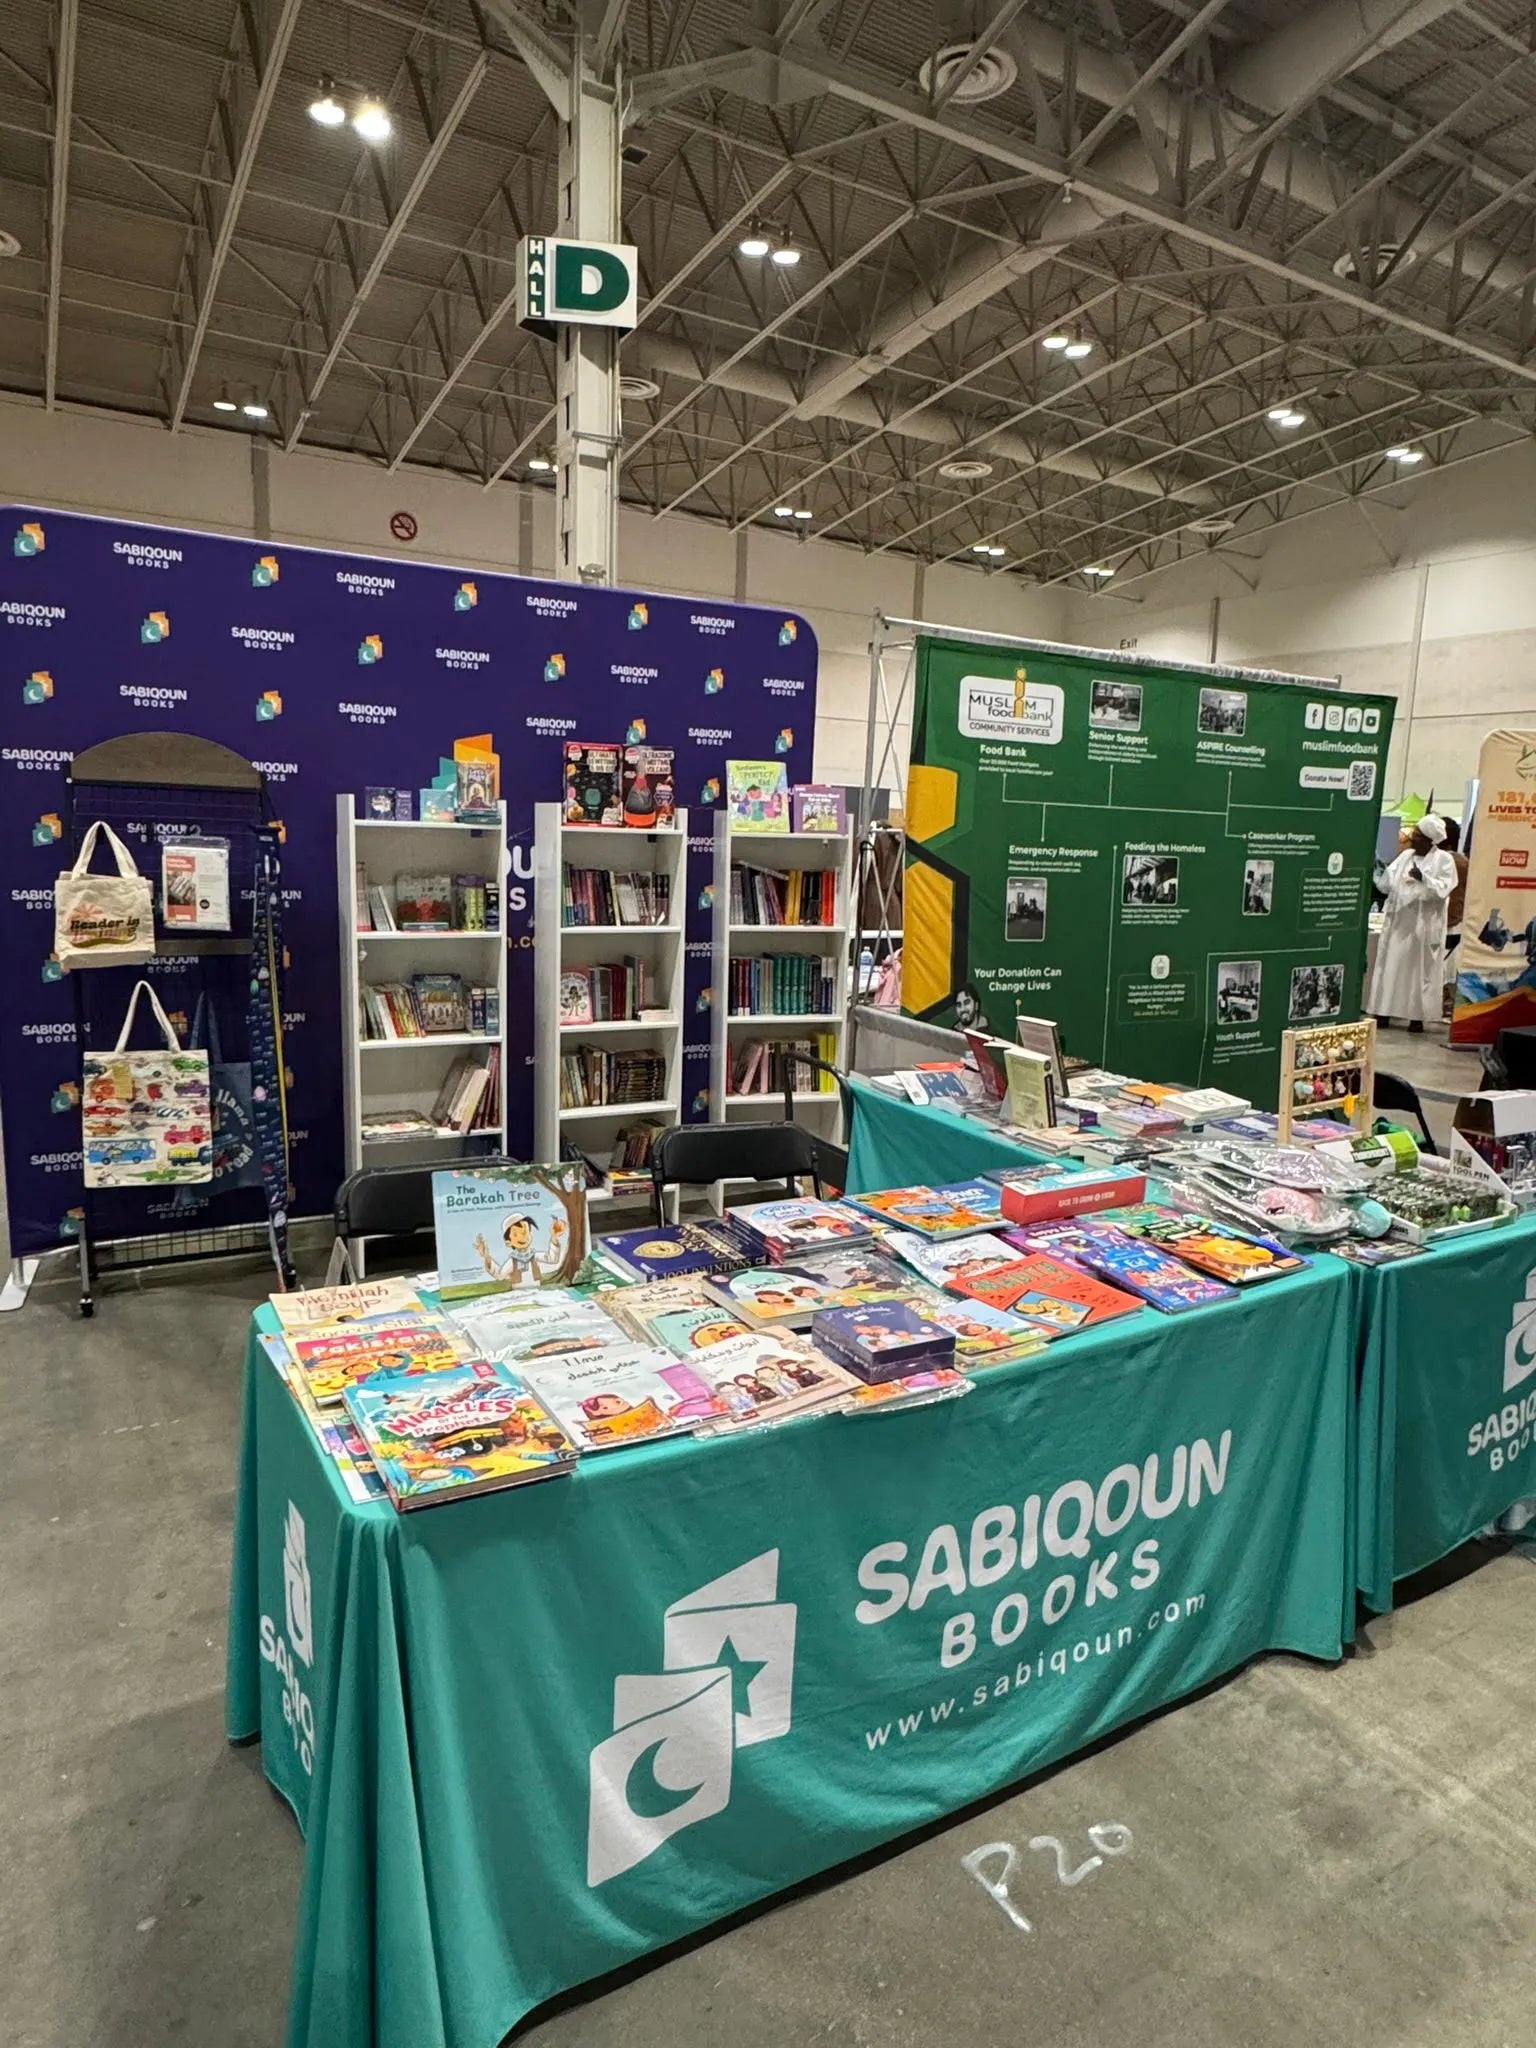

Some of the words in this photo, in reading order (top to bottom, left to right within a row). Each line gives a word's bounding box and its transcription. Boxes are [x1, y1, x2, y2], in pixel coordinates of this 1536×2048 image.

[529, 240, 544, 316] HALL
[555, 245, 630, 312] D
[113, 542, 182, 562] SABIQOUN
[127, 556, 169, 569] BOOKS
[336, 572, 395, 589] SABIQOUN
[348, 585, 384, 596] BOOKS
[0, 602, 65, 619] ABIQOUN
[526, 596, 577, 612] SABIQOUN
[536, 607, 567, 618] BOOKS
[7, 615, 52, 628] BOOKS
[690, 615, 735, 630] SABIQOUN
[231, 627, 295, 643] SABIQOUN
[700, 625, 726, 636] BOOKS
[244, 640, 283, 651] BOOKS
[1120, 638, 1138, 650] Exit
[436, 648, 490, 663] SABIQOUN
[446, 659, 479, 671] BOOKS
[611, 665, 658, 679] SABIQOUN
[620, 675, 648, 685] BOOKS
[763, 678, 804, 691] SABIQOUN
[120, 685, 187, 701] SABIQOUN
[771, 687, 796, 697] BOOKS
[133, 697, 174, 709] BOOKS
[338, 703, 397, 717] SABIQOUN
[526, 717, 576, 730] SABIQOUN
[969, 722, 1015, 735] COMMUNITY
[1017, 726, 1050, 737] SERVICES
[536, 726, 567, 737] BOOKS
[688, 728, 732, 740] SABIQOUN
[1089, 730, 1115, 741] Senior
[1116, 733, 1148, 745] Support
[696, 736, 723, 747] BOOKS
[1197, 741, 1224, 752] ASPIRE
[1303, 740, 1378, 755] muslimfoodbank
[1, 748, 73, 762] SABIQOUN
[980, 744, 1003, 755] Food
[1005, 746, 1027, 757] Bank
[17, 761, 60, 771] BOOKS
[252, 761, 298, 774] BIQOUN
[1304, 773, 1327, 783] Donate
[1488, 805, 1522, 814] LIVES
[1248, 831, 1286, 842] Caseworker
[1287, 833, 1316, 843] Program
[1009, 844, 1057, 858] Emergency
[1059, 846, 1098, 858] Response
[1125, 841, 1155, 853] Feeding
[1157, 843, 1169, 852] the
[1170, 843, 1206, 853] Homeless
[11, 889, 55, 901] SABIQ
[974, 968, 995, 979] Your
[998, 967, 1041, 979] Donation
[1043, 967, 1062, 977] Can
[988, 981, 1026, 993] Change
[1027, 981, 1051, 991] Lives
[1216, 1031, 1235, 1042] Youth
[1235, 1029, 1260, 1042] Support
[456, 1185, 475, 1195] The
[446, 1191, 504, 1207] Barakah
[508, 1190, 540, 1200] Tree
[312, 1333, 431, 1356] Pakistan
[388, 1400, 513, 1434] MIRACLES
[1467, 1389, 1536, 1456] SABIQ
[414, 1416, 492, 1435] Prophets
[1490, 1420, 1536, 1471] BOO
[855, 1430, 1232, 1624] SABIQOUN
[940, 1539, 1160, 1668] BOOKS
[866, 1594, 1206, 1751] www.sabiqoun.com
